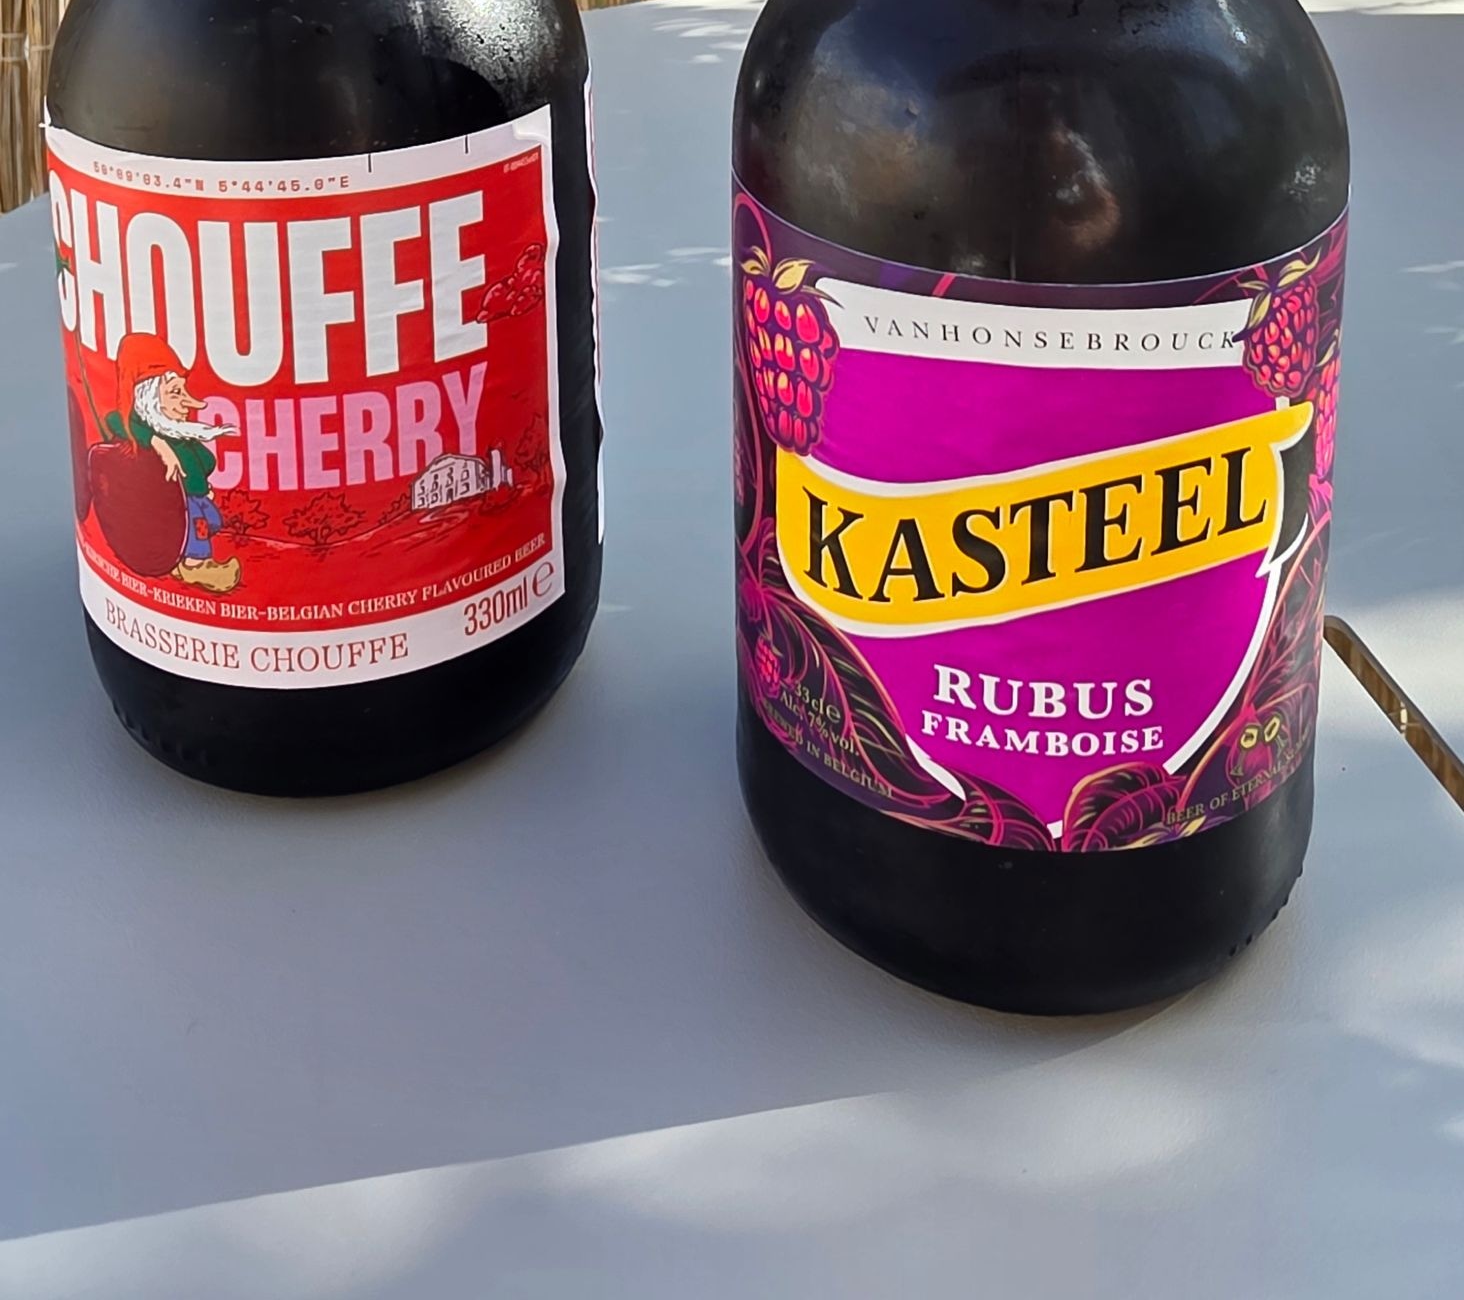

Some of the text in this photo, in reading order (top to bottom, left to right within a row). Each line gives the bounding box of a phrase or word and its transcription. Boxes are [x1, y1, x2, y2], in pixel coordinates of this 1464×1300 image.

[48, 168, 489, 388] CHOUFFE
[863, 315, 1236, 351] VANHONSEBROUCK
[197, 360, 489, 492] CHERRY
[802, 446, 1267, 603] KASTEEL
[348, 589, 418, 615] CHERRY
[422, 554, 512, 601] FLAVOURED
[514, 532, 545, 563] BEER
[105, 597, 409, 673] BRASSERIE CHOUFFE
[463, 575, 529, 636] 330ml
[933, 663, 1154, 720] RUBUS
[921, 709, 1164, 758] FRAMBOISE
[823, 752, 895, 799] BELGIUM
[1166, 803, 1206, 826] BEER
[1209, 793, 1229, 811] OF
